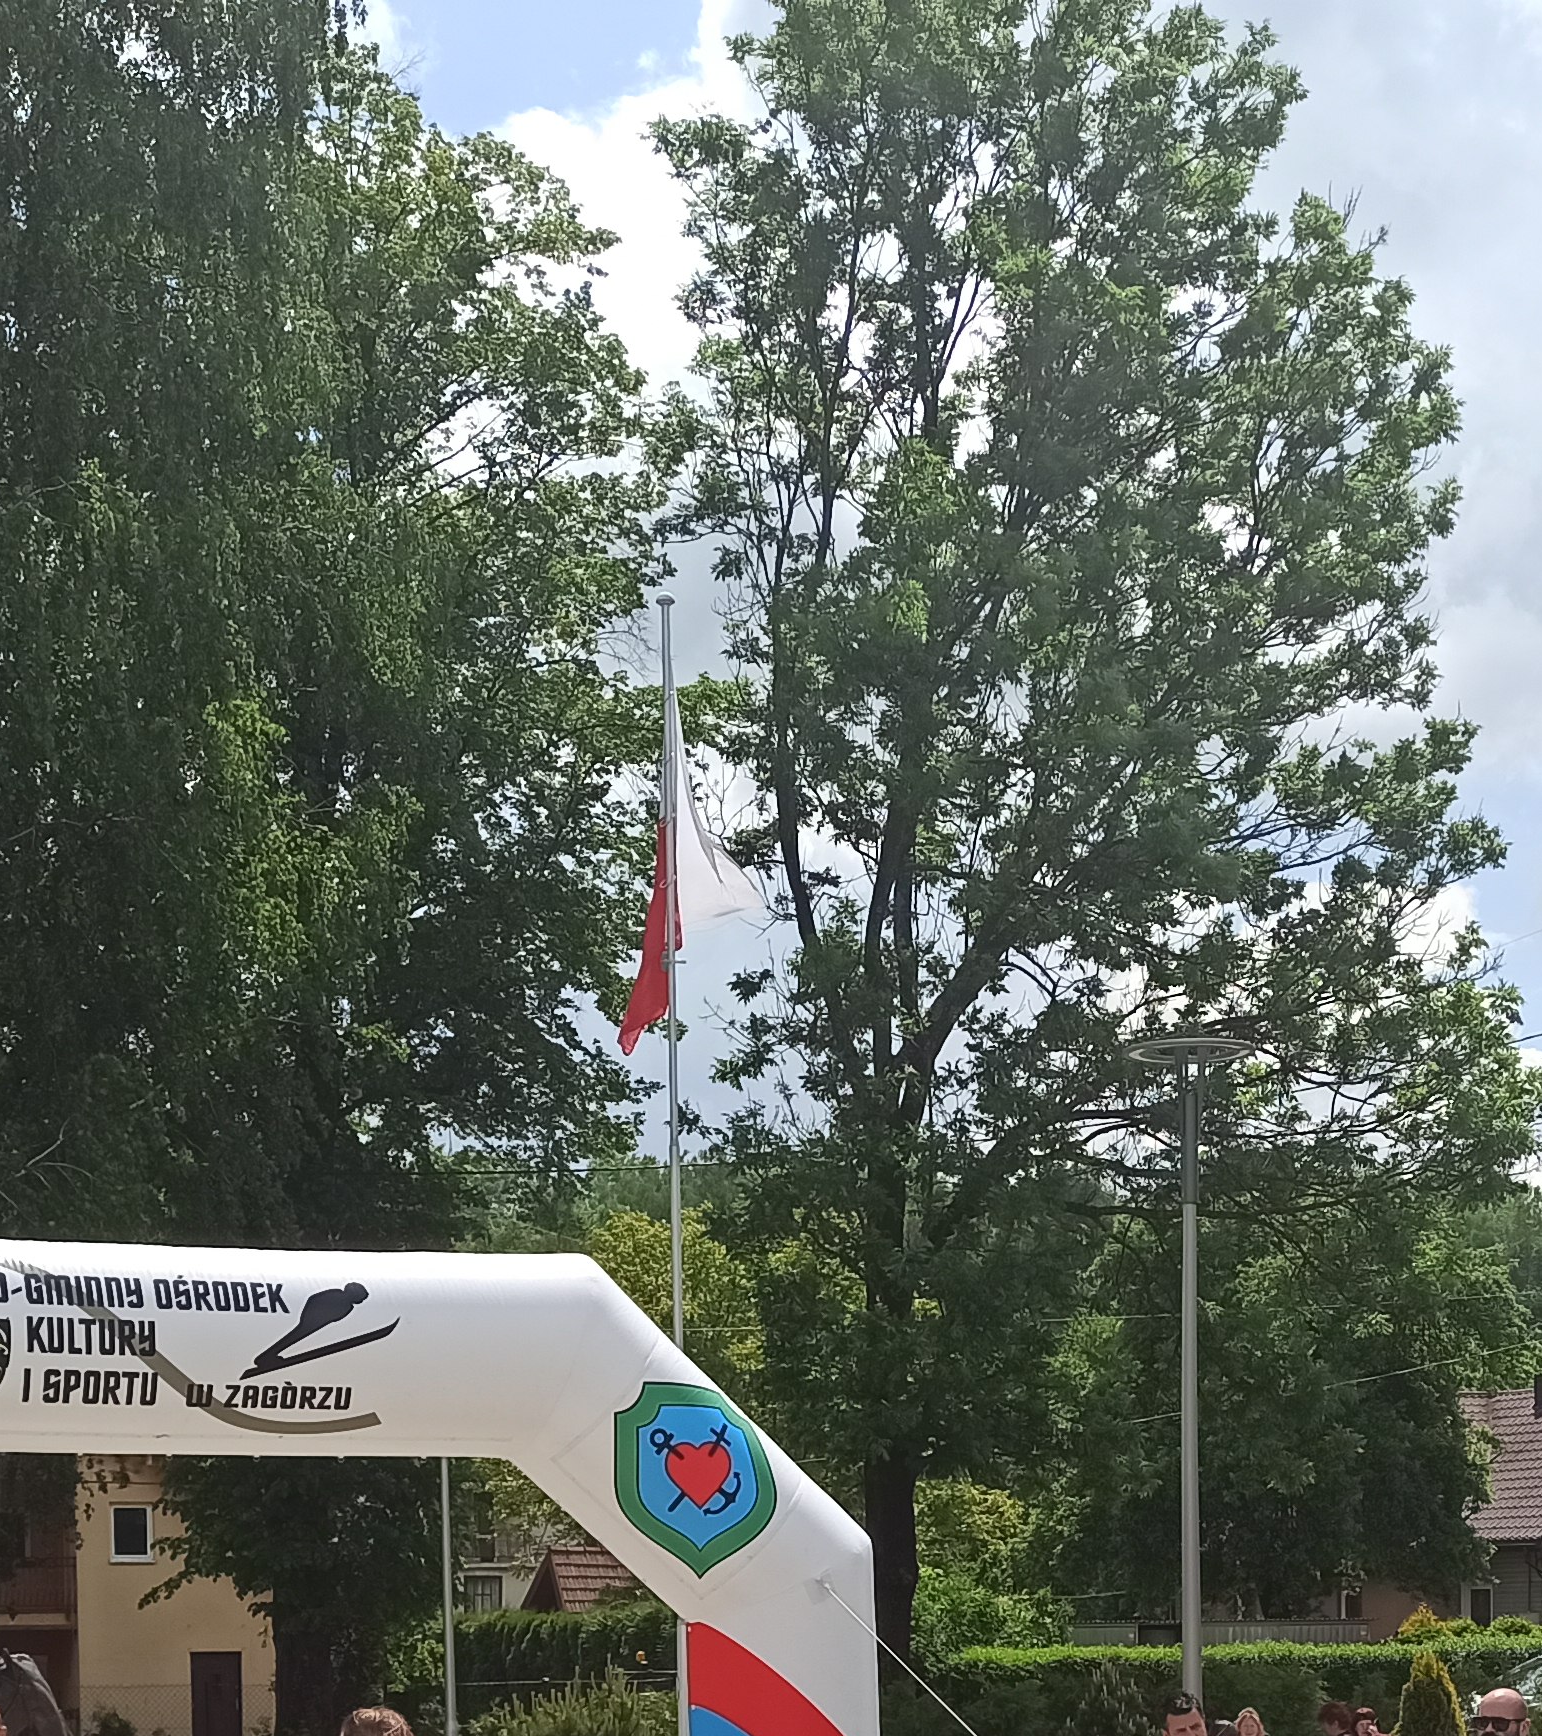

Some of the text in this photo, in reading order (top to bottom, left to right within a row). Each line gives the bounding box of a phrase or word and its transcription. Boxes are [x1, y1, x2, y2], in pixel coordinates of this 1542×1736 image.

[153, 1274, 291, 1314] OŚRODEK
[26, 1315, 156, 1357] KULTURY
[22, 1368, 159, 1406] I SPORTU
[186, 1384, 214, 1408] W
